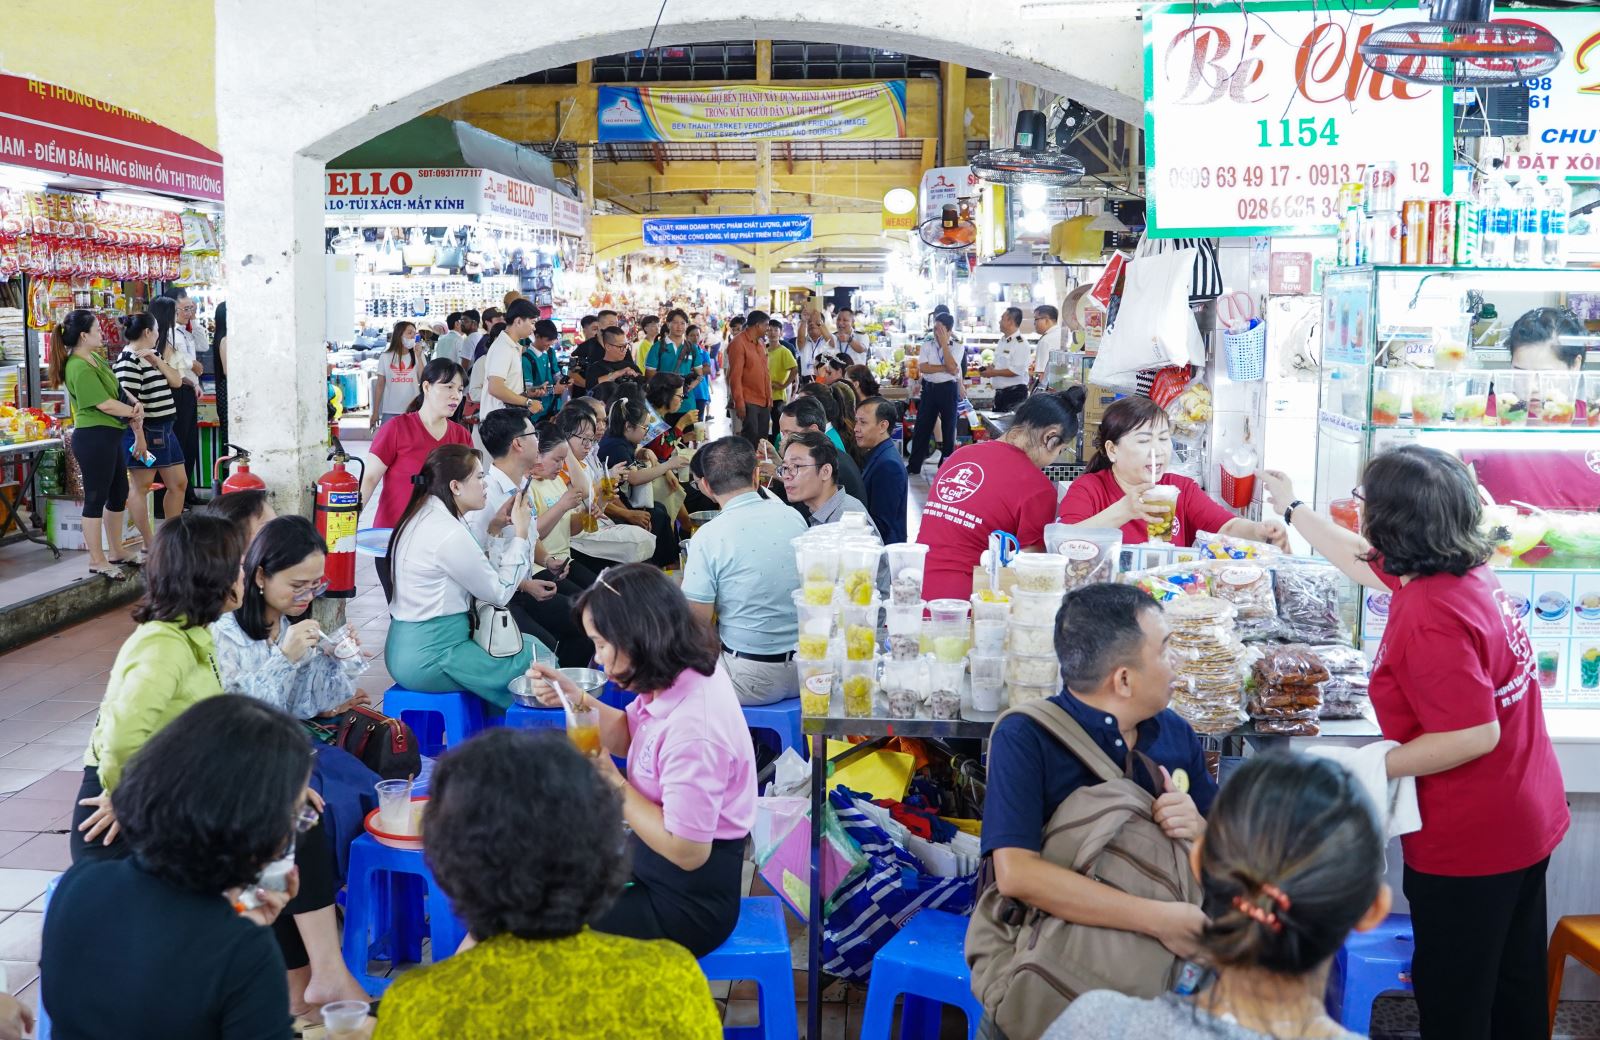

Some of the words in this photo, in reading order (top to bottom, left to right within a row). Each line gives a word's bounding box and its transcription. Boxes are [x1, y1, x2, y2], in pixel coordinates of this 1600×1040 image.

[1164, 25, 1270, 106] Bé
[671, 122, 686, 130] BEN
[688, 122, 712, 130] THANH
[713, 122, 741, 130] MARKET
[743, 122, 777, 130] VENDORS
[1257, 117, 1339, 147] 1154
[1541, 128, 1600, 143] CHU
[35, 140, 67, 166] ĐIỂM
[69, 148, 93, 170] BÁN
[95, 154, 127, 177] HÀNG
[128, 160, 153, 182] BÌNH
[170, 171, 185, 191] THỊ
[185, 174, 221, 194] TRƯỜNG
[1518, 152, 1559, 174] ĐẶT
[325, 172, 413, 196] ELLO
[1168, 167, 1210, 189] 0909
[1216, 166, 1237, 188] 63
[1243, 165, 1264, 187] 49
[1270, 165, 1290, 187] 17
[1309, 164, 1350, 185] 0913
[349, 197, 368, 210] TÚI
[370, 196, 401, 210] XÁCH
[407, 194, 432, 210] MẮT
[435, 196, 465, 210] KÍNH
[507, 180, 535, 207] HELLO
